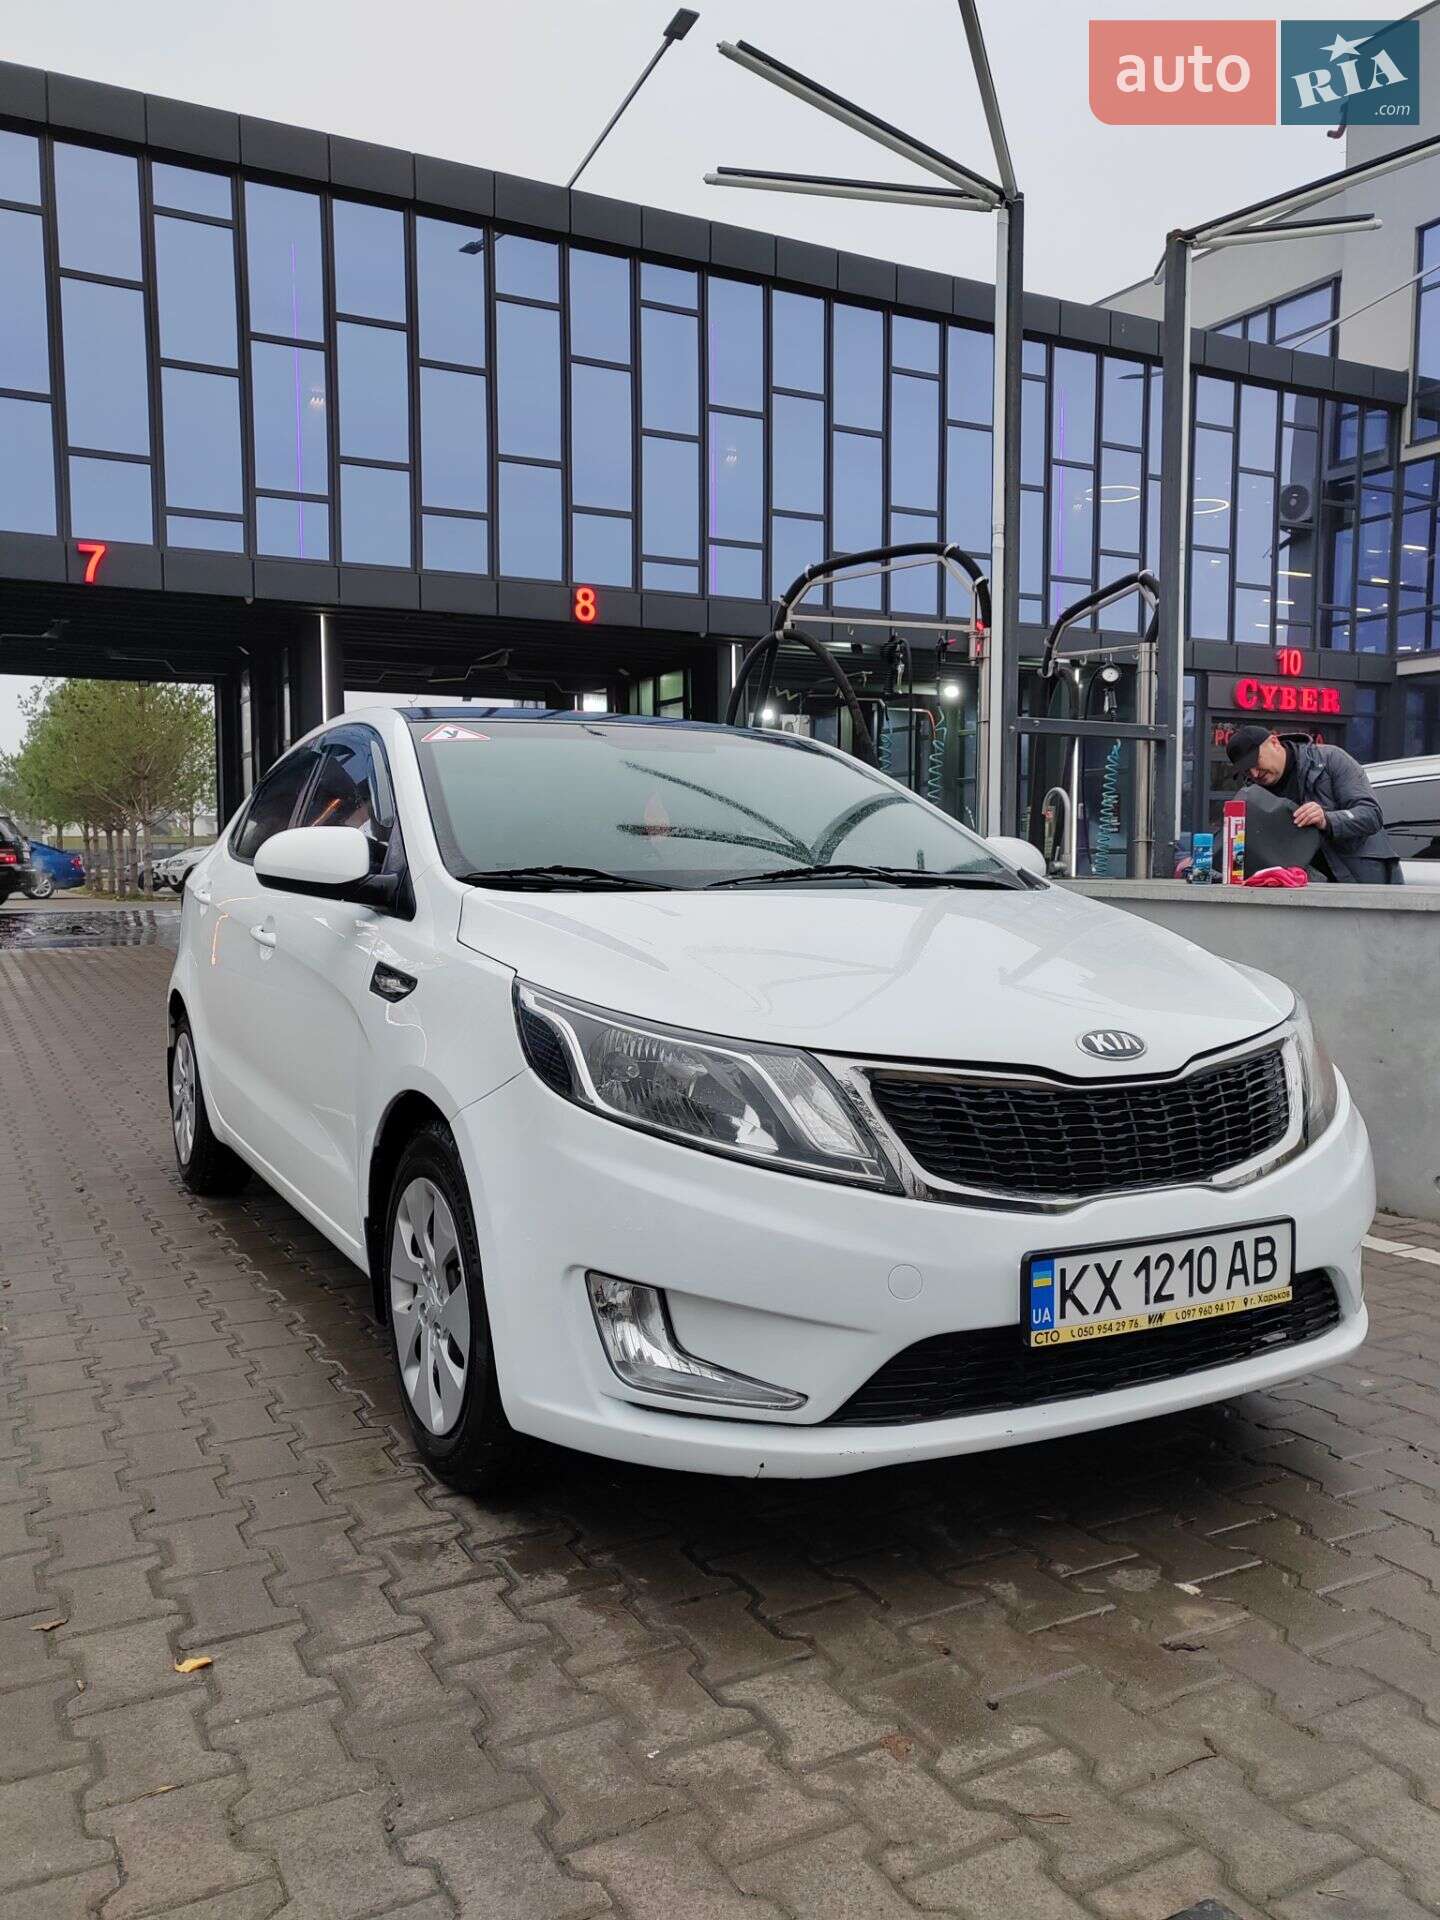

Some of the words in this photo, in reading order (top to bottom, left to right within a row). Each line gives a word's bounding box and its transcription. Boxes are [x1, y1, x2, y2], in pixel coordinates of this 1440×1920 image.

[77, 543, 106, 585] 7
[575, 586, 597, 623] 8
[1276, 648, 1303, 676] 10
[1087, 1033, 1142, 1052] KIA
[1059, 1259, 1123, 1320] KX
[1133, 1246, 1217, 1305] 1210
[1226, 1235, 1278, 1290] AB
[1032, 1307, 1052, 1324] UA
[1077, 1327, 1094, 1338] 050
[1097, 1323, 1113, 1335] 954
[1115, 1320, 1126, 1332] 29
[1128, 1319, 1139, 1329] 76
[1181, 1309, 1196, 1320] 097
[1198, 1305, 1212, 1316] 960
[1214, 1303, 1225, 1314] 94
[1226, 1301, 1236, 1311] 17
[1258, 1290, 1290, 1304] Харьков
